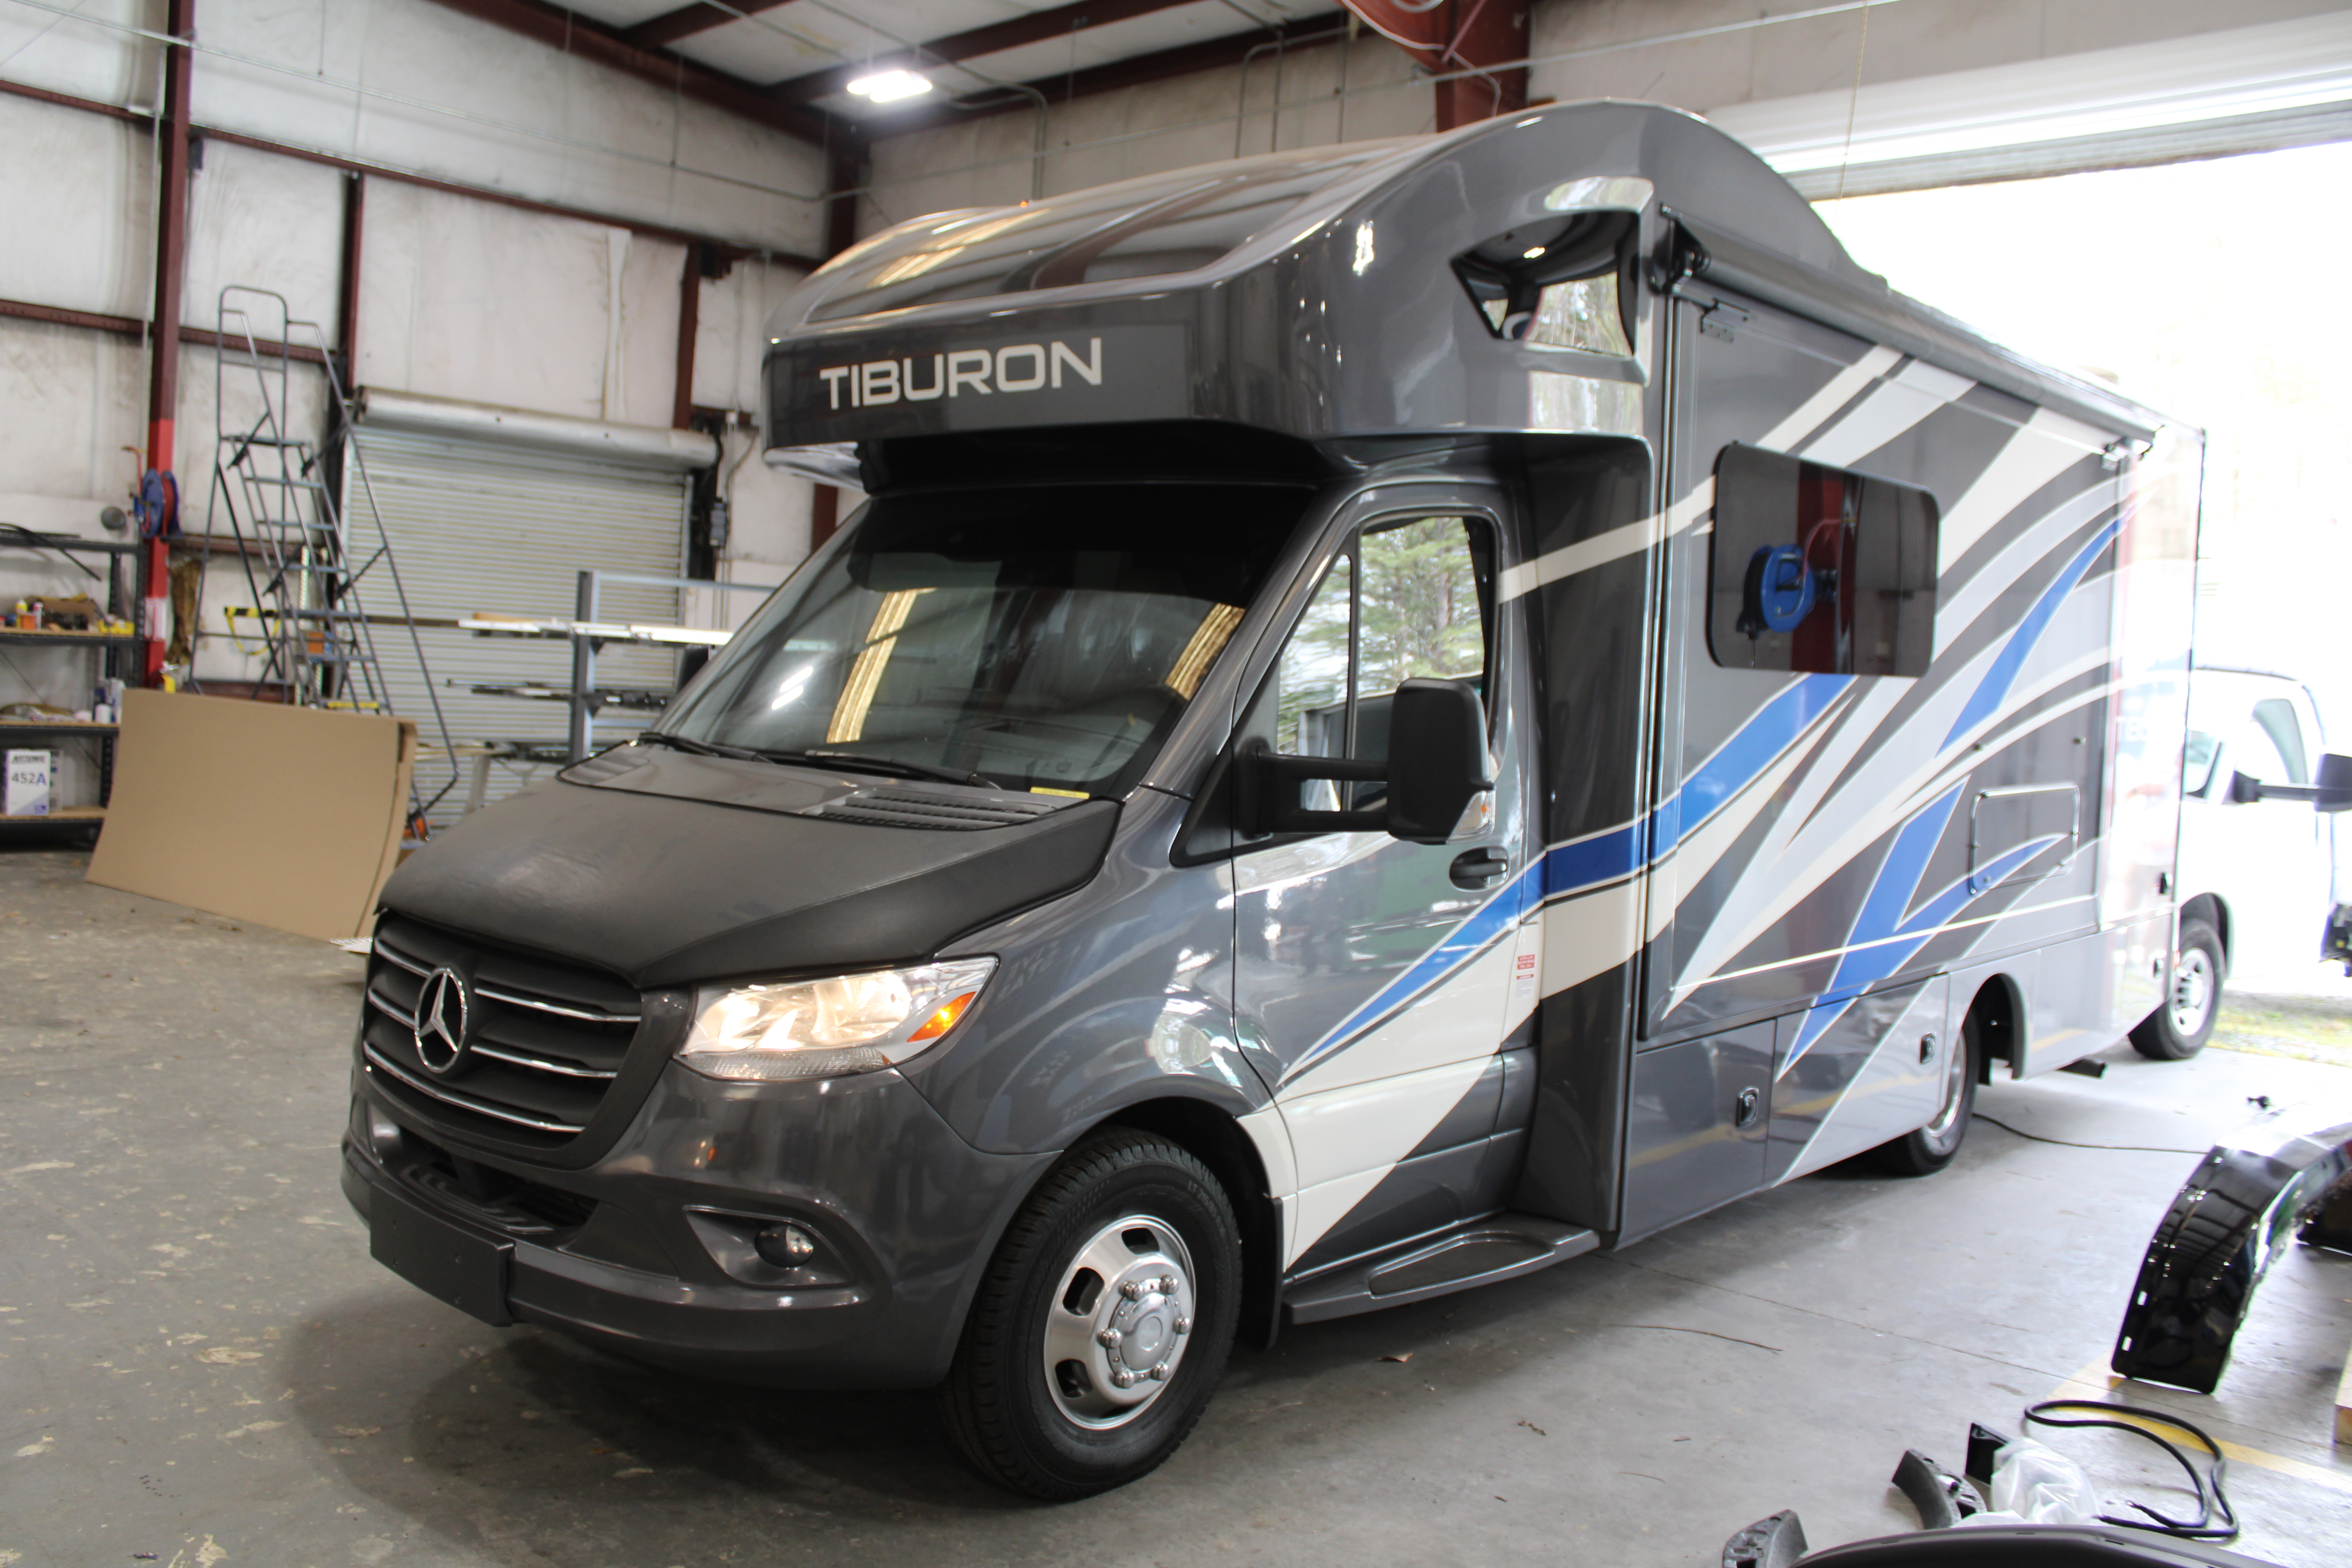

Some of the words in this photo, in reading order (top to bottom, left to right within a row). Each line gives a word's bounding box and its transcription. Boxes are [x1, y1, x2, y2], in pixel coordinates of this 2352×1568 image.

[820, 338, 1102, 410] TIBURON
[11, 773, 46, 785] 452A
[1188, 1181, 1198, 1194] LT
